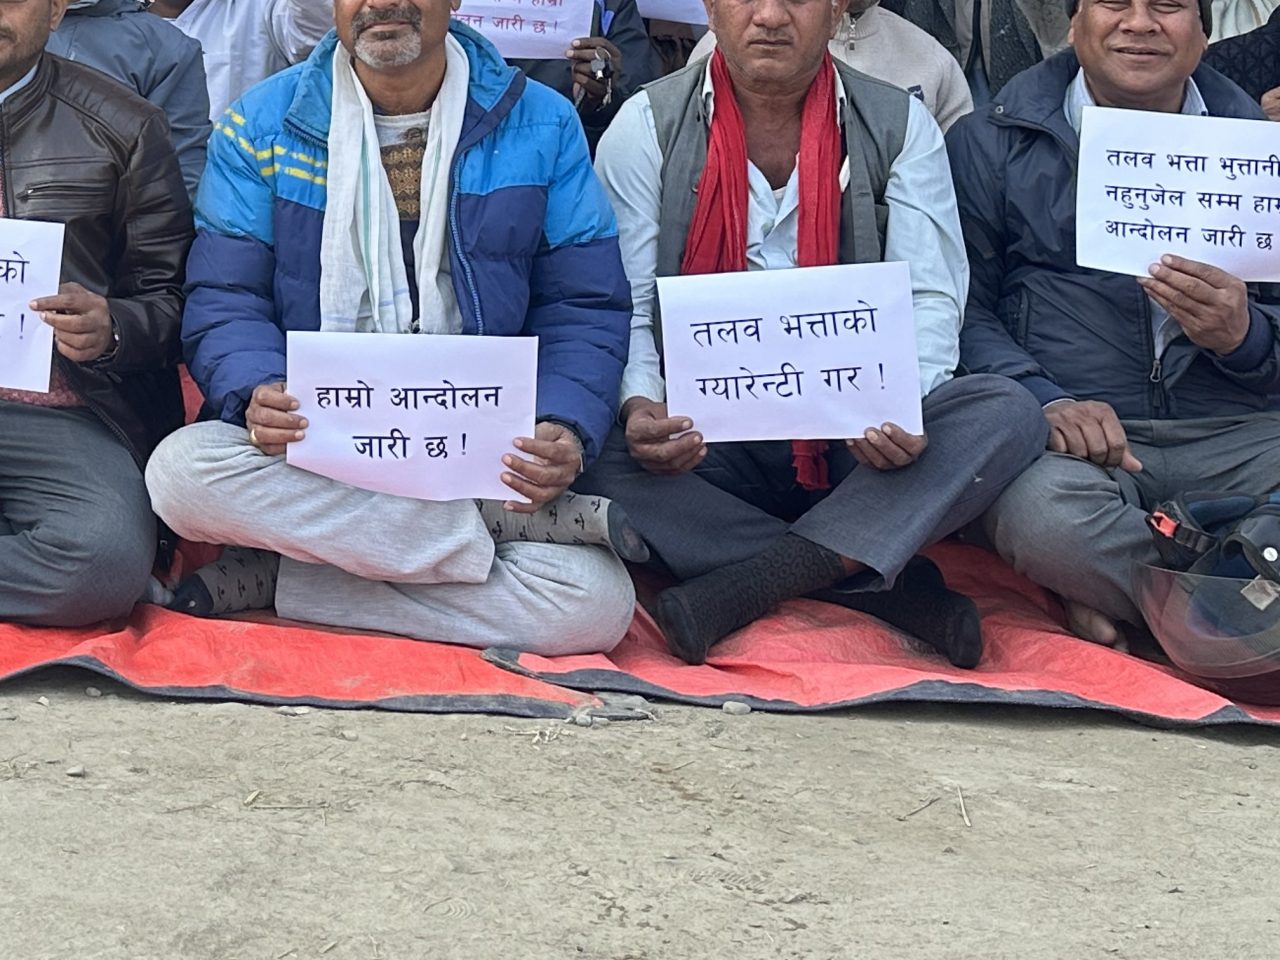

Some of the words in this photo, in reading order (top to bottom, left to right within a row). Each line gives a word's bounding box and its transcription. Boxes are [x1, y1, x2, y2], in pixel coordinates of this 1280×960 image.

[491, 13, 526, 31] जारी
[531, 19, 548, 35] छ
[1106, 149, 1157, 169] तलव
[1166, 154, 1209, 173] भत्ता
[1219, 153, 1280, 181] भुत्तानी
[1104, 183, 1186, 211] नहुनुजेल
[1196, 192, 1243, 211] सम्म
[1105, 218, 1191, 244] आन्दोलन
[1201, 224, 1247, 248] जारी
[1255, 232, 1274, 251] छ
[689, 317, 763, 347] तलव
[779, 299, 878, 339] भत्ताको
[315, 379, 375, 409] हाम्रो
[390, 379, 503, 410] आन्दोलन
[695, 362, 805, 401] ग्यारेन्टी
[819, 366, 862, 393] गर
[351, 427, 411, 459] जारी
[423, 435, 448, 459] छ
